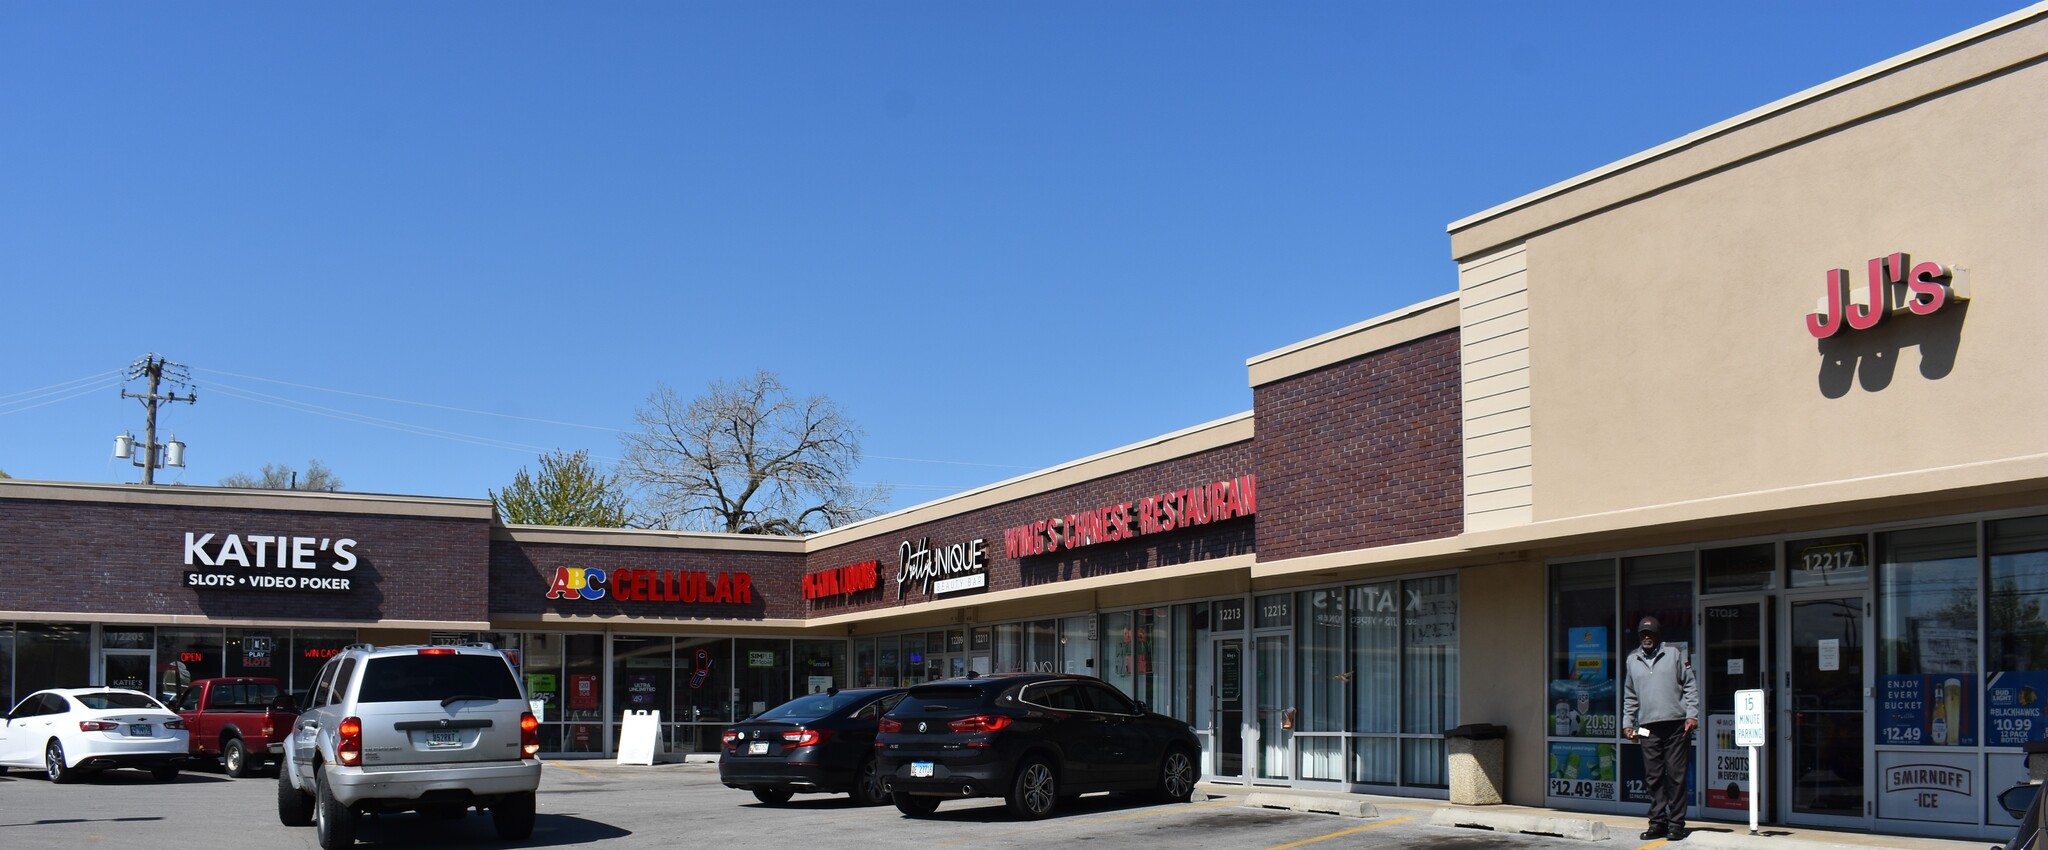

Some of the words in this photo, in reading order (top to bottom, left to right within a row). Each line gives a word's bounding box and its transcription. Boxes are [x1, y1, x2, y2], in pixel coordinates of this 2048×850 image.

[1806, 252, 1947, 338] JJ's
[1005, 518, 1058, 559] WING'S
[1063, 501, 1133, 549] CHINESE
[1140, 474, 1256, 535] RESTAURAN
[184, 532, 357, 571] KATIE'S
[1803, 551, 1854, 571] 12217
[189, 574, 235, 586] SLOTS
[249, 576, 297, 588] VIDEO
[300, 577, 350, 590] POKER
[546, 566, 606, 600] ABC
[611, 567, 752, 604] CELLULAR
[937, 580, 964, 592] BEAUTY
[967, 576, 983, 588] BAR
[1220, 608, 1240, 620] 12213
[1264, 604, 1287, 617] 12215
[114, 632, 144, 641] 12205
[181, 652, 202, 662] OPEN
[304, 649, 319, 658] WIN
[243, 658, 271, 667] SLOTS
[1887, 681, 1919, 689] ENJOY
[1888, 691, 1918, 699] EVERY
[1744, 697, 1754, 711] 15
[1884, 702, 1922, 710] BUCKET
[1739, 714, 1760, 725] MINUTE
[1993, 719, 2032, 731] $10.99
[1738, 729, 1762, 739] PARKING
[1882, 727, 1921, 740] $12.49
[1717, 757, 1724, 770] 2
[1724, 757, 1749, 771] SHOTS
[1718, 772, 1723, 780] IN
[1724, 772, 1739, 780] EVERY
[1893, 769, 1964, 788] SMIRNOFF
[1552, 780, 1592, 797] $12.49
